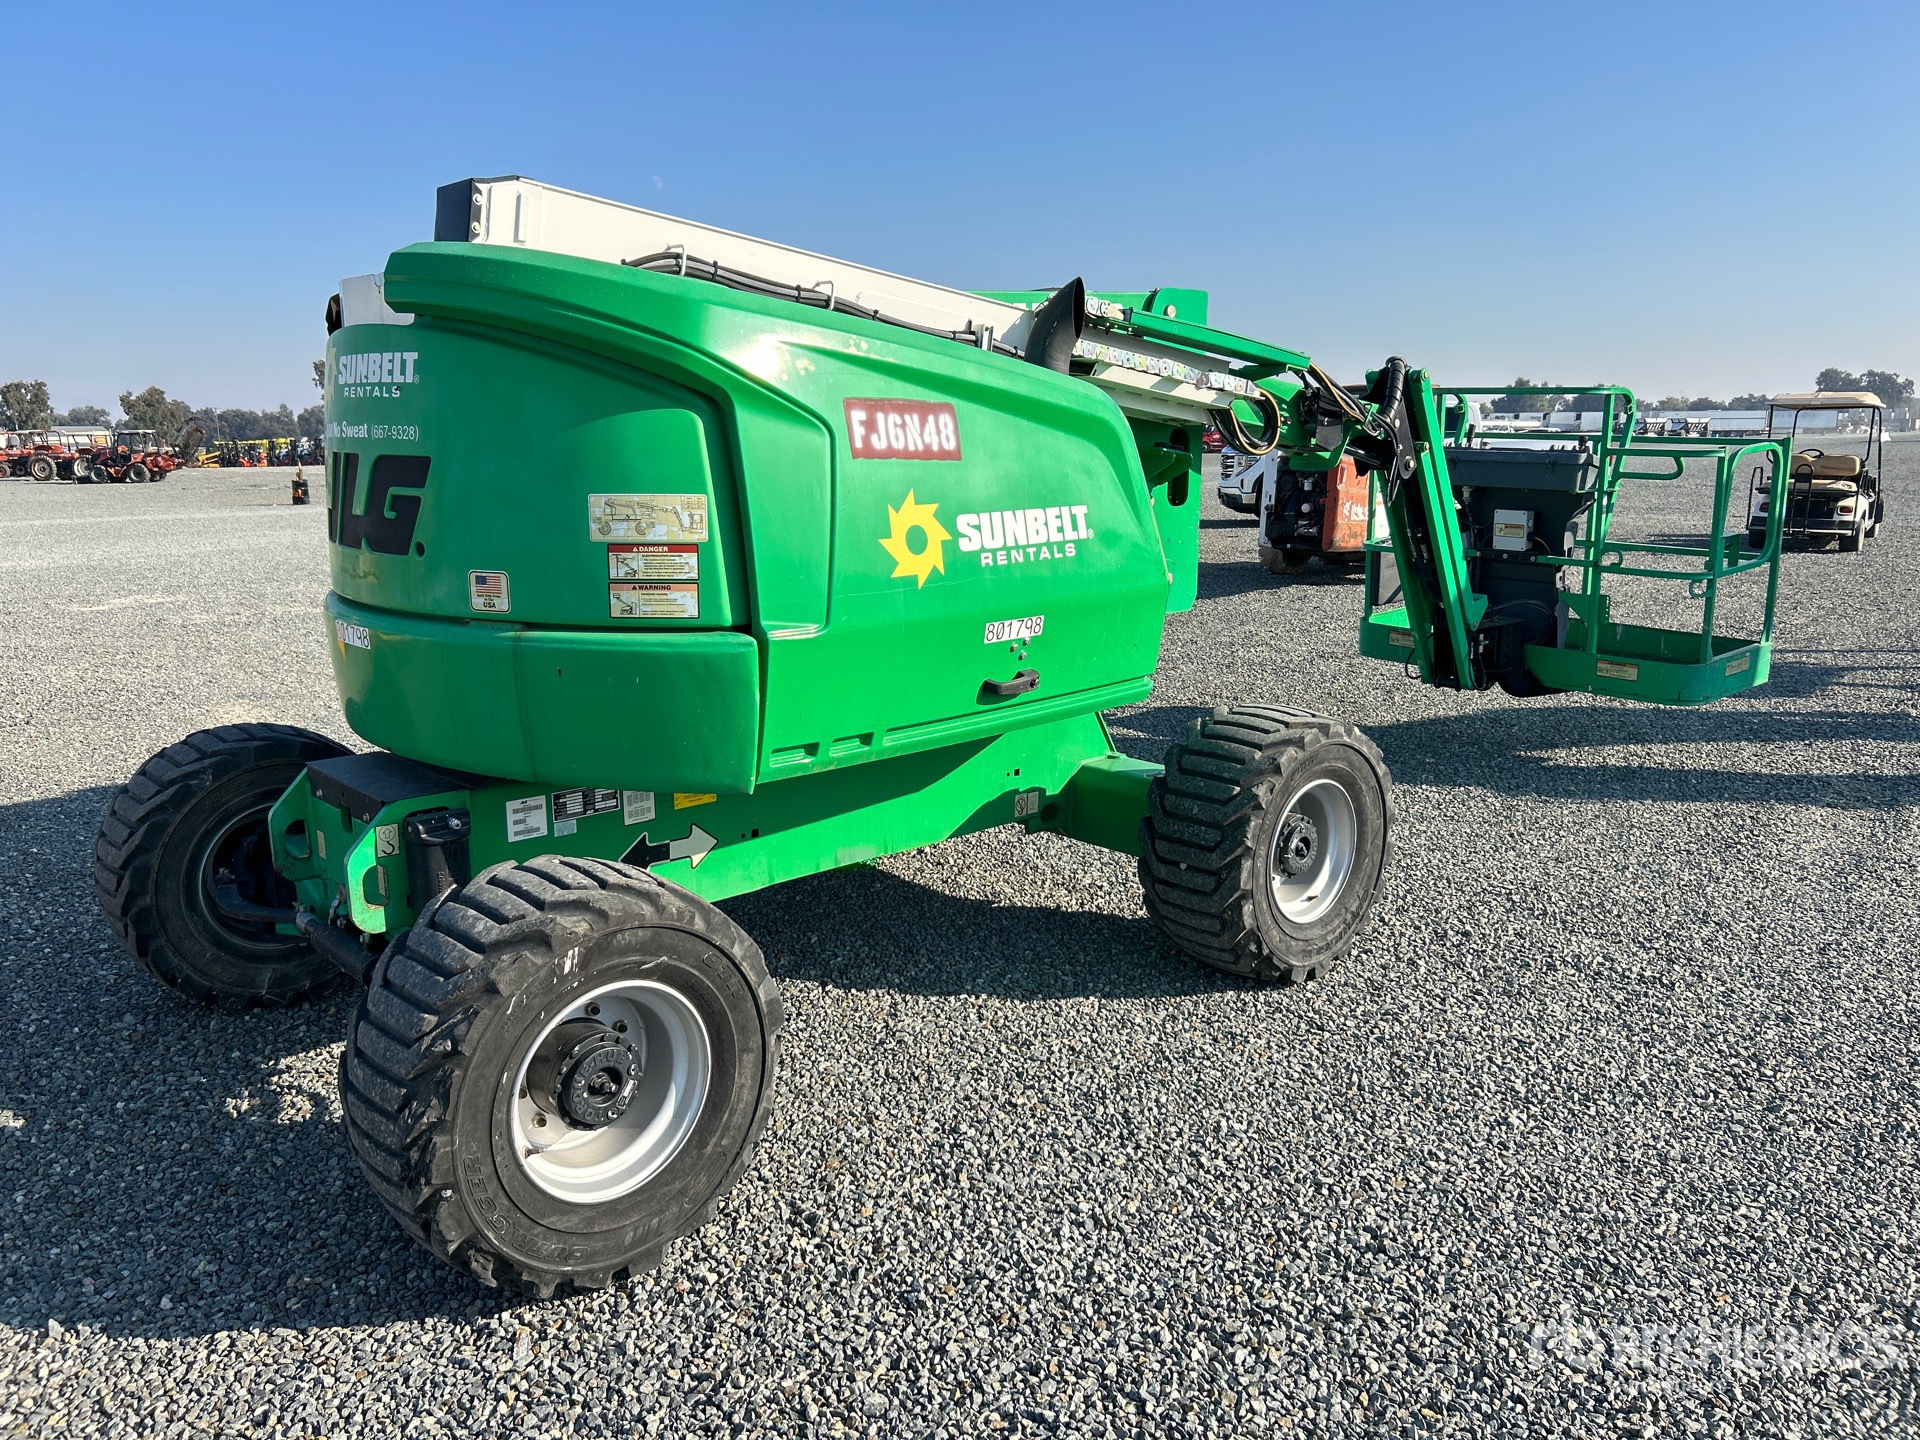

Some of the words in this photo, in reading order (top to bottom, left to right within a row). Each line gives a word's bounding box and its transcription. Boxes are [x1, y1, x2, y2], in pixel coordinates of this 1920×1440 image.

[343, 385, 400, 398] RENTALS
[341, 420, 368, 438] Sweat
[371, 424, 419, 442] (667-9328)
[980, 542, 1077, 568] RENTALS
[986, 616, 1042, 641] 801798
